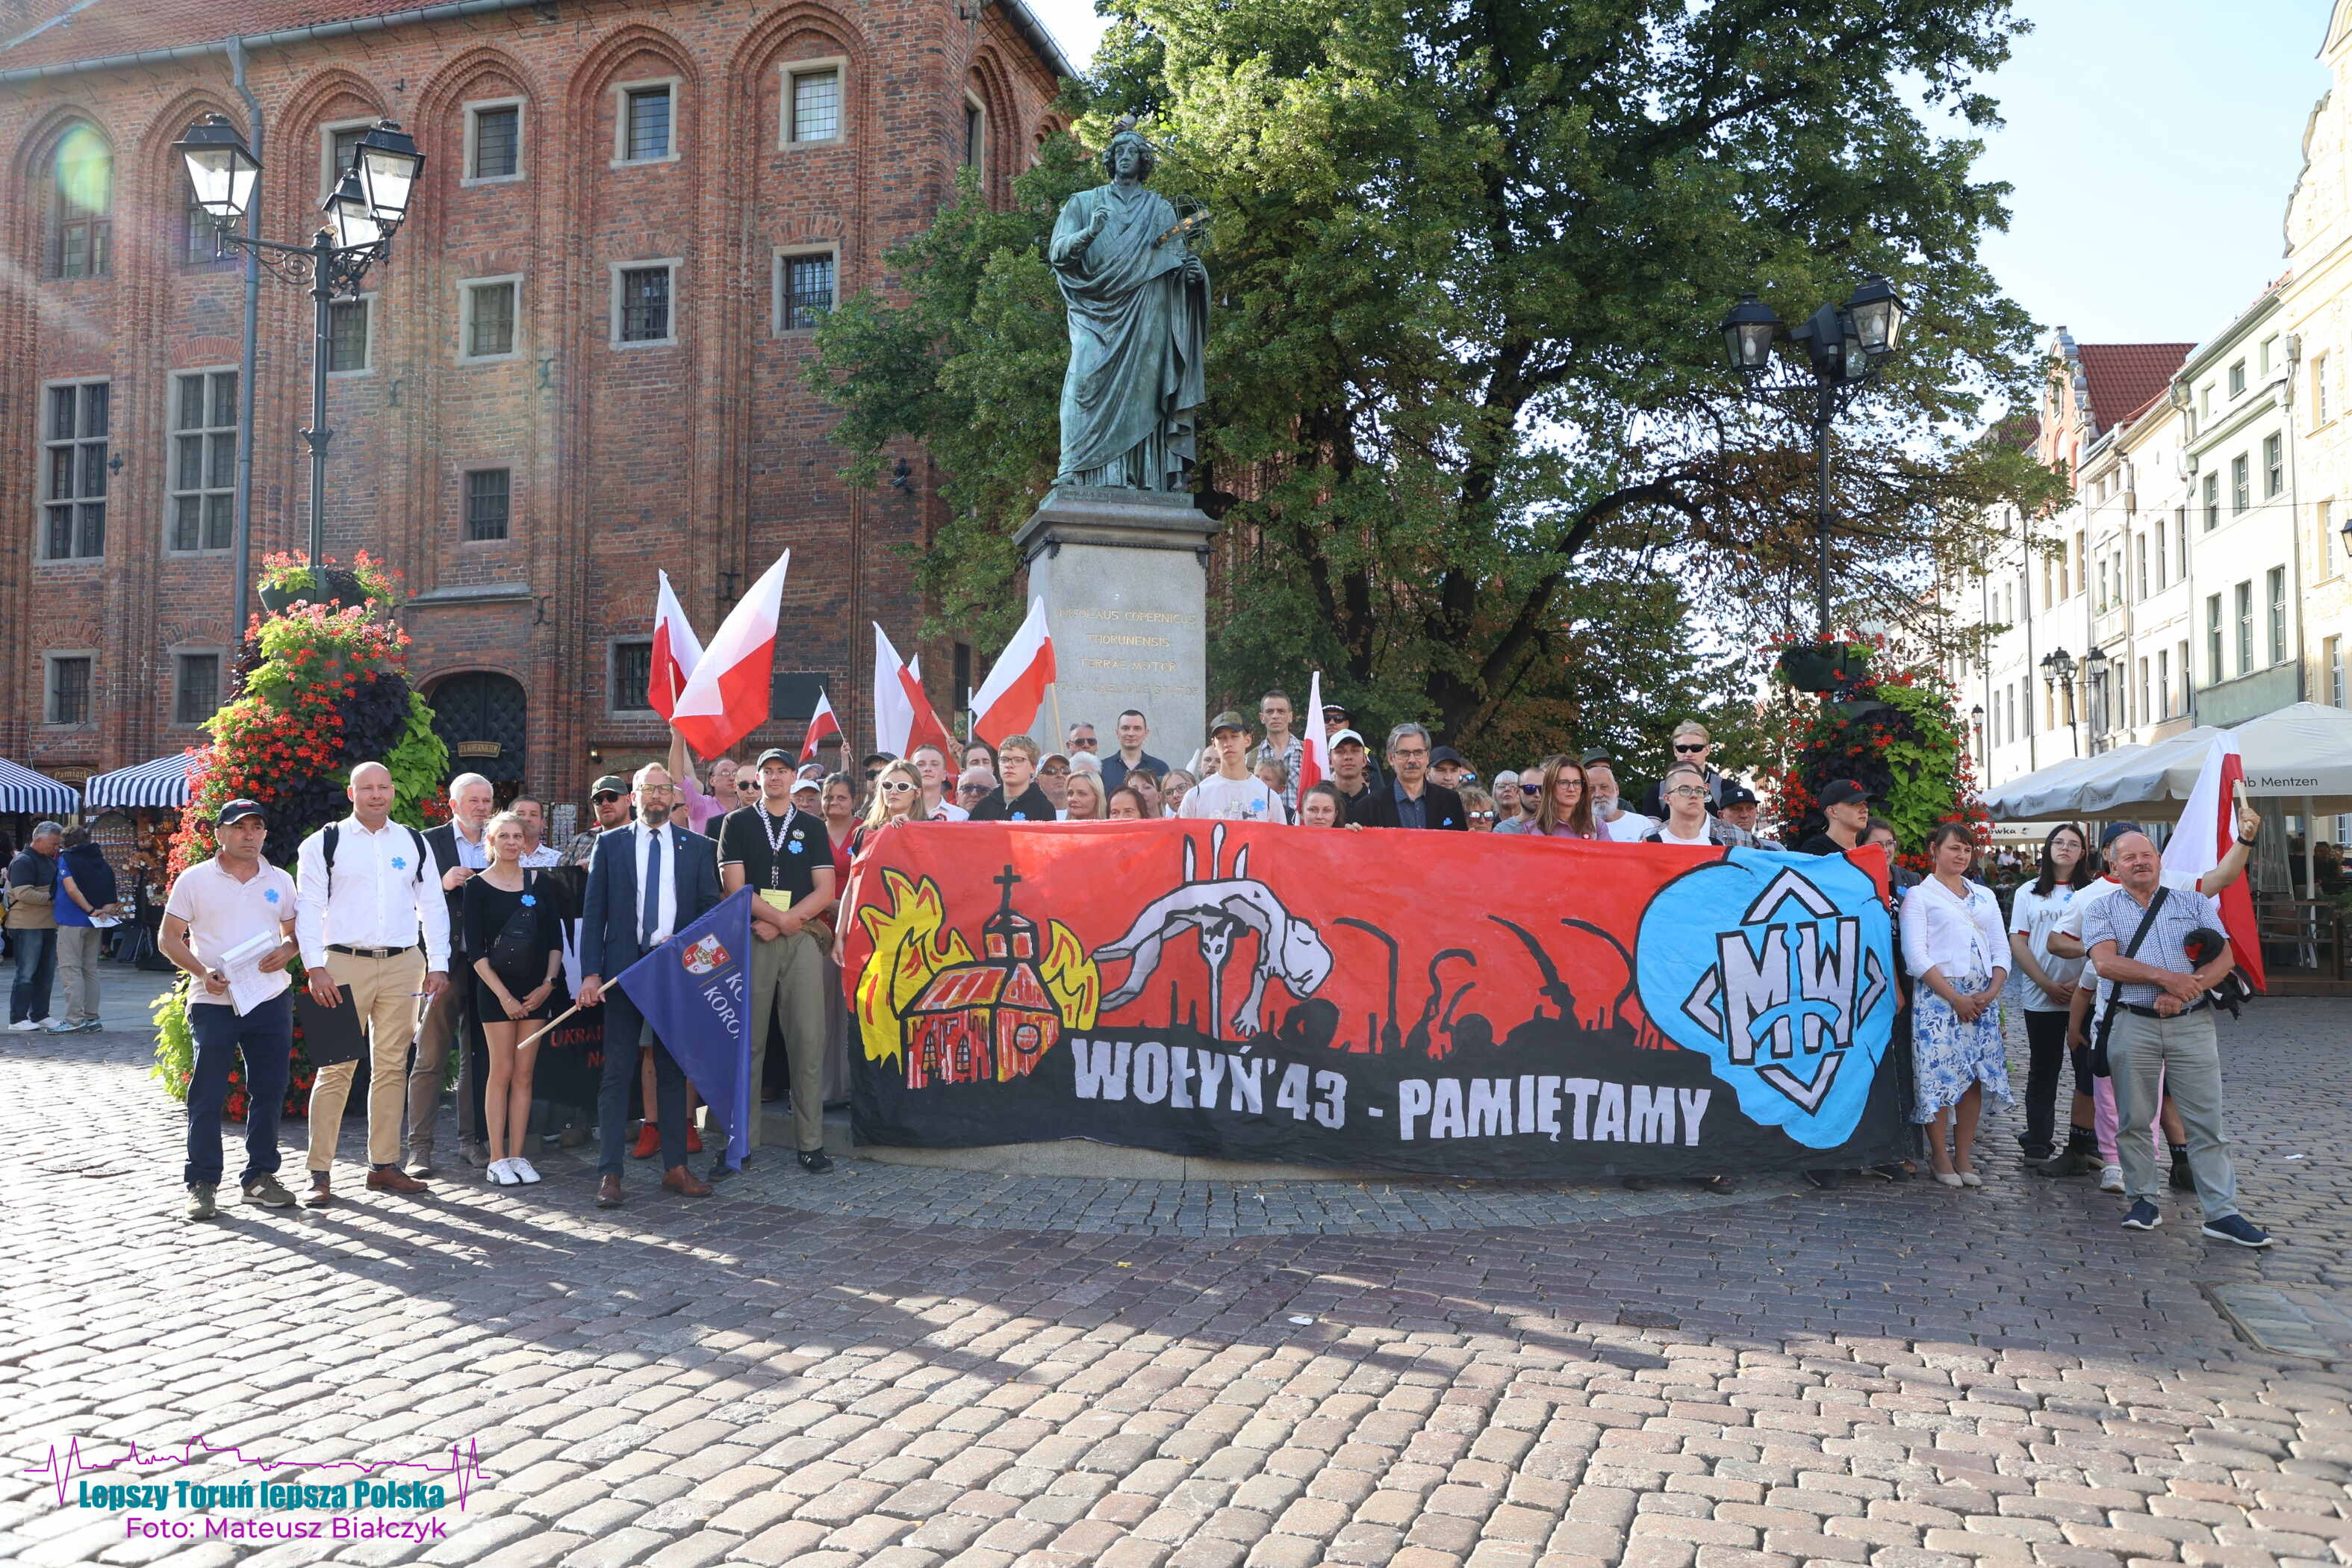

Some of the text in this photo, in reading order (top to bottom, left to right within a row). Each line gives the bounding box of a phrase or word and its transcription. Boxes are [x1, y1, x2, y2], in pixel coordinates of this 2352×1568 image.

[1124, 611, 1196, 624] COPERNICUS
[1085, 633, 1171, 647] THORUNENSIS
[2262, 776, 2318, 788] Mentzen
[1071, 1038, 1347, 1130] WOŁYŃ'43
[1399, 1074, 1711, 1146] PAMIĘTAMY
